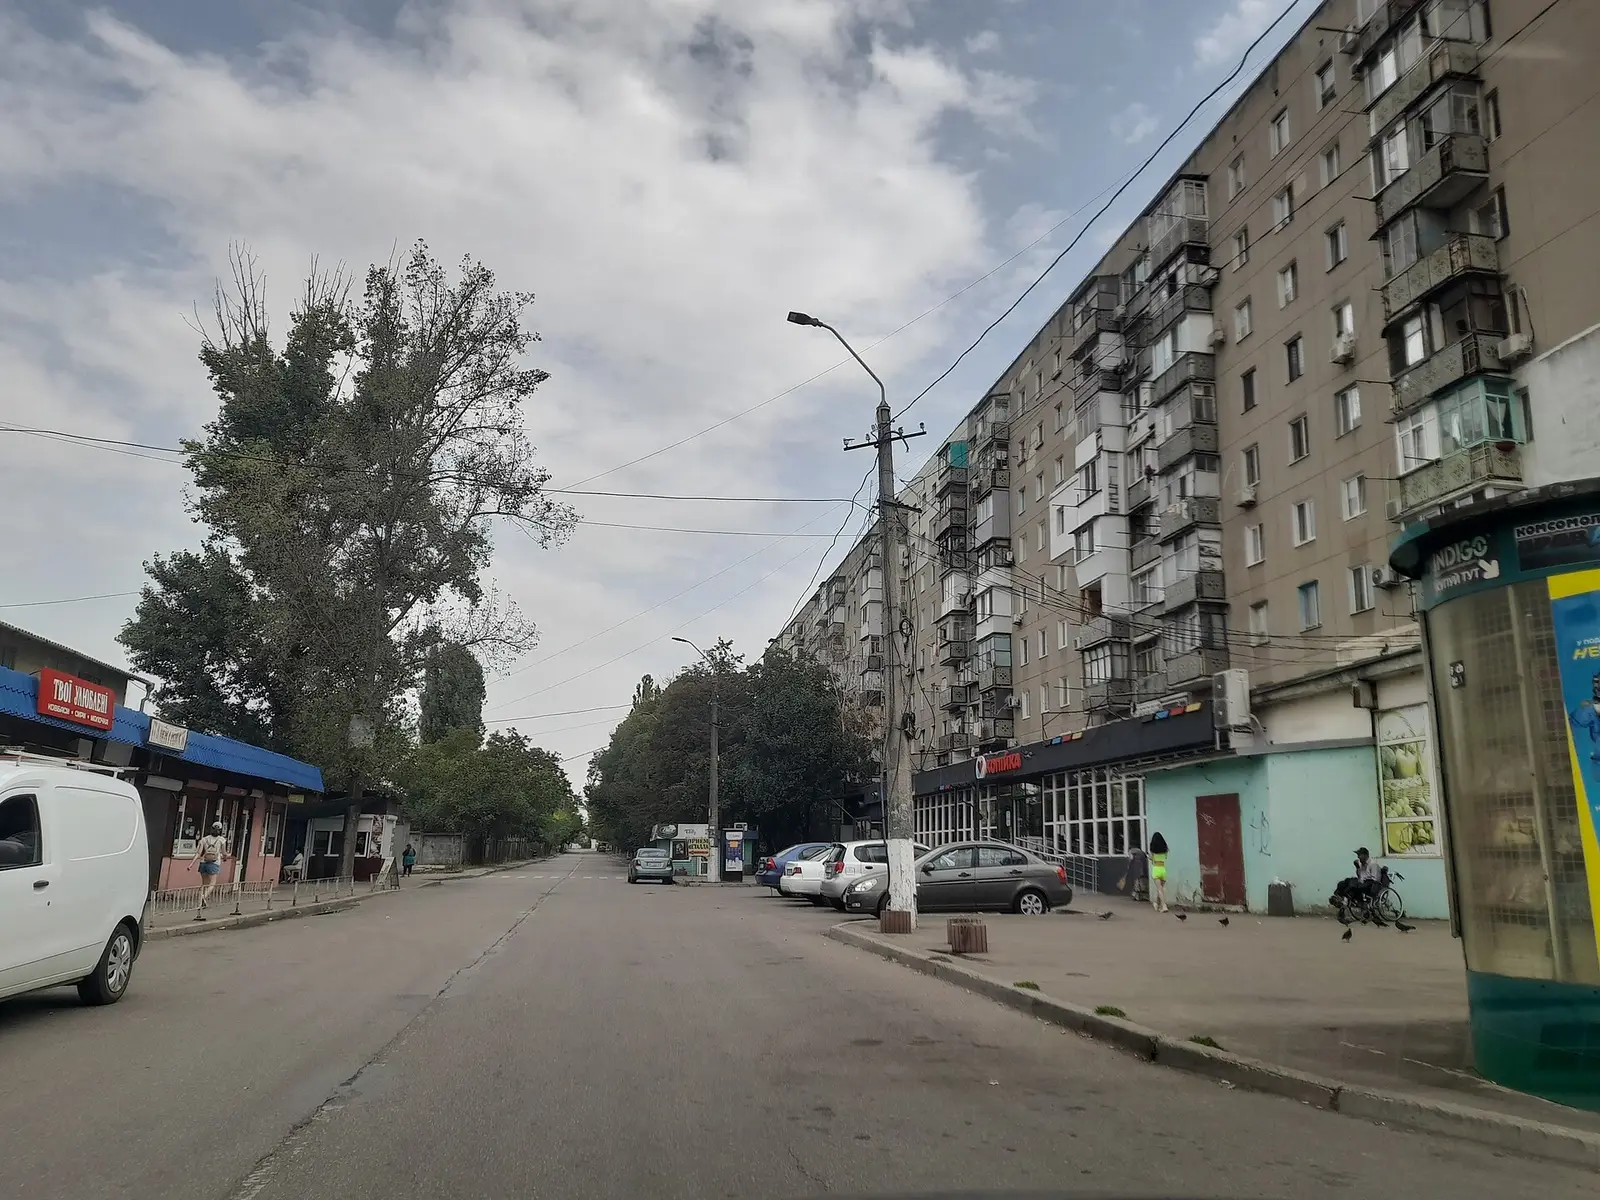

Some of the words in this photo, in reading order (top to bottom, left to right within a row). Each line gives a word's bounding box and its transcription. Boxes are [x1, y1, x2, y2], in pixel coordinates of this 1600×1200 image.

[1432, 536, 1488, 572] INDIGO
[1460, 567, 1481, 582] ТУТ
[1572, 645, 1600, 661] НЕ
[53, 678, 73, 704] ТВОЇ
[73, 685, 109, 714] УЛЮБЛЕНІ
